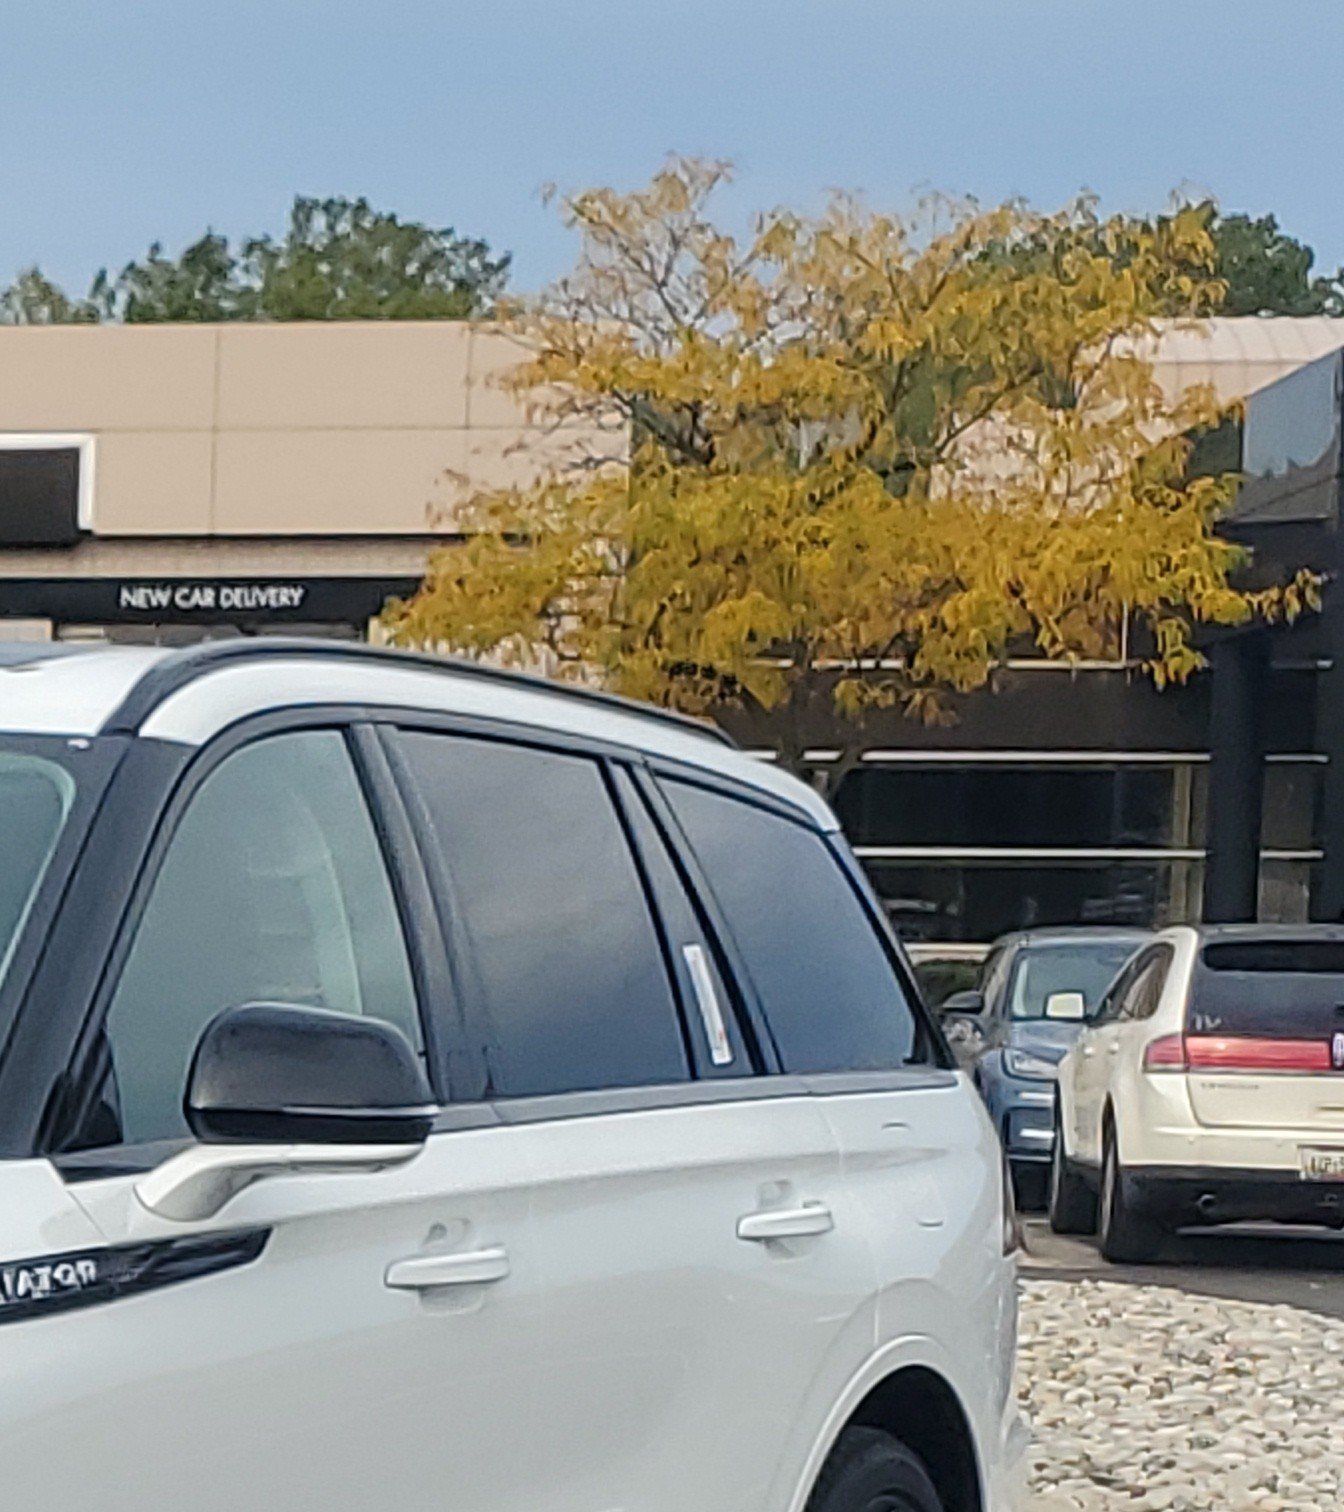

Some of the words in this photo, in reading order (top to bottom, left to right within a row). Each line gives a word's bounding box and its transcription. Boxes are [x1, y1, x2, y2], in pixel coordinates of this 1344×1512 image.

[119, 585, 170, 609] NEW
[174, 585, 215, 609] CAR
[219, 584, 305, 609] DELIVERY
